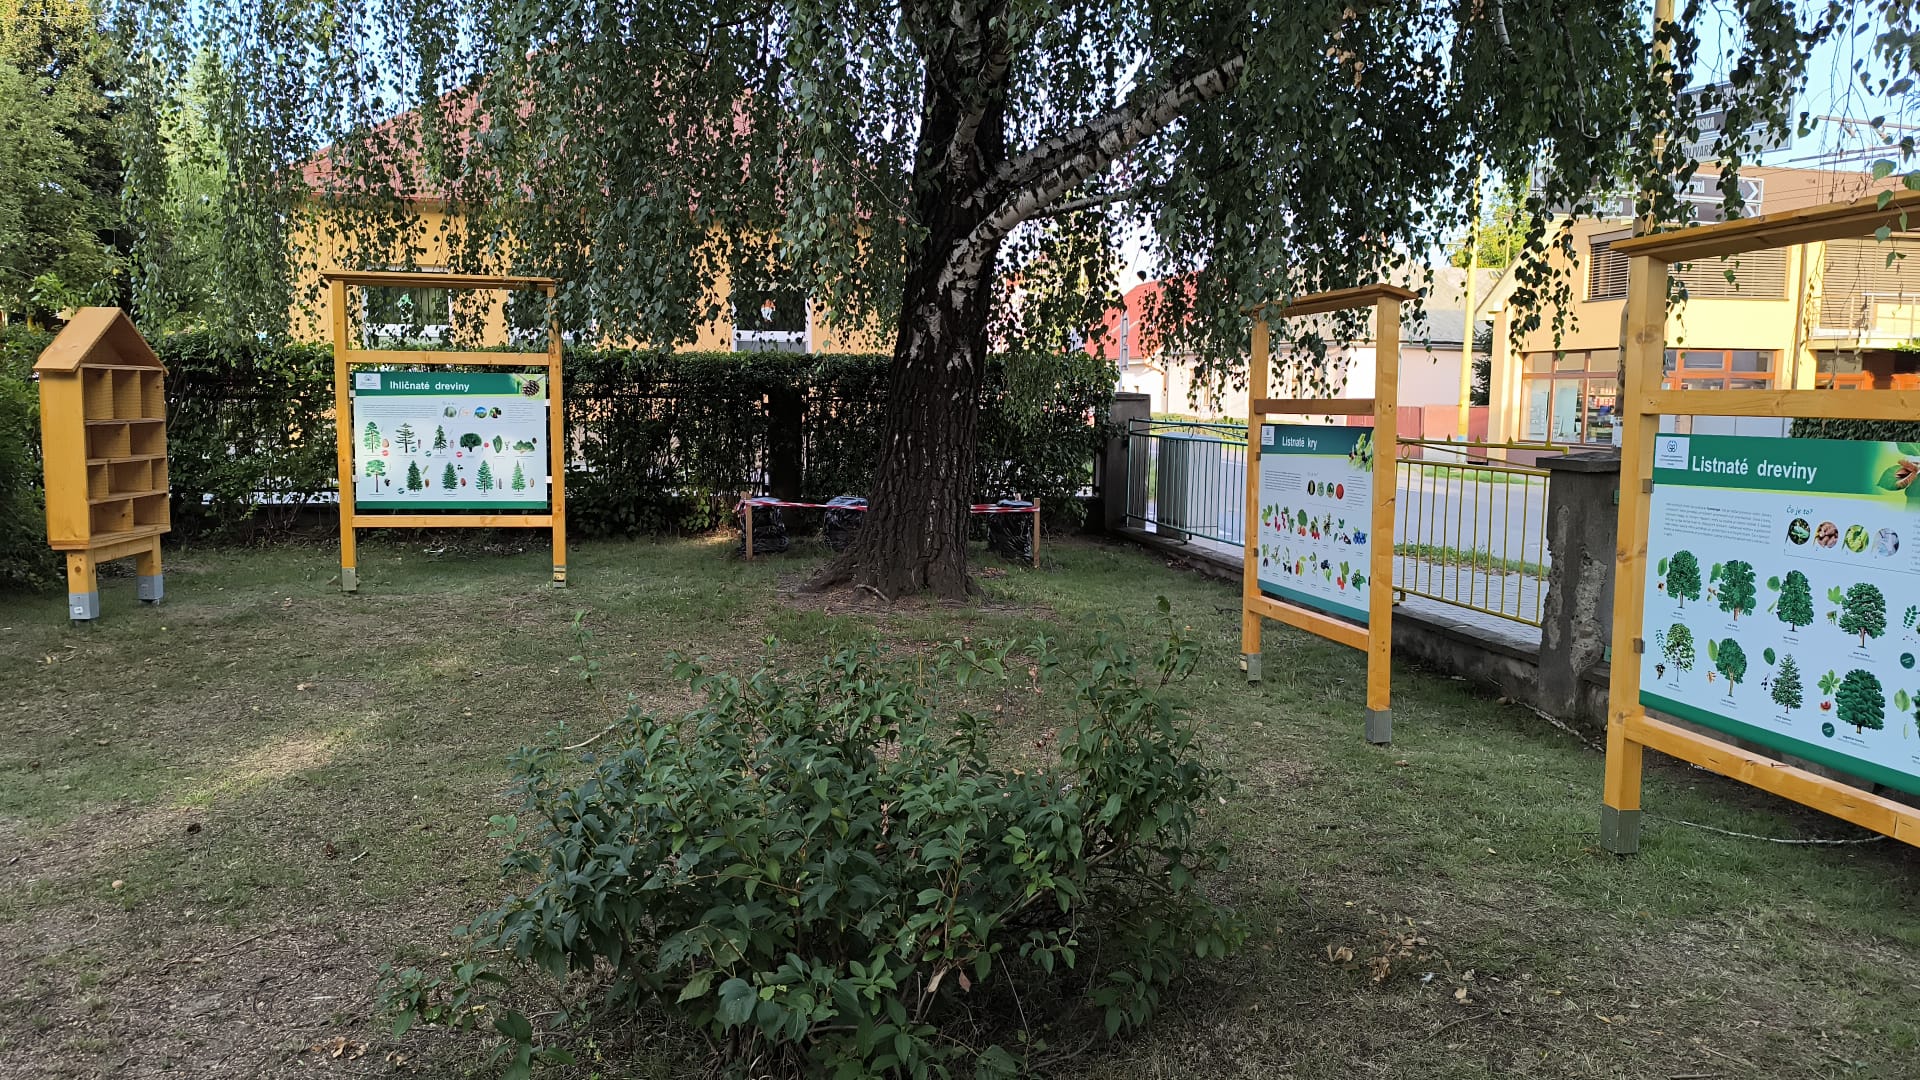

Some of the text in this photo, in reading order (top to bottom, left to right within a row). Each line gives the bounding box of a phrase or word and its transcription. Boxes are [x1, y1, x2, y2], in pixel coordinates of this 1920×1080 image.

[390, 381, 470, 393] Ihličnaté dreviny
[1282, 435, 1305, 448] Listnaté
[1307, 436, 1318, 451] kry
[1692, 455, 1749, 475] Listnaté
[1757, 459, 1817, 485] dreviny
